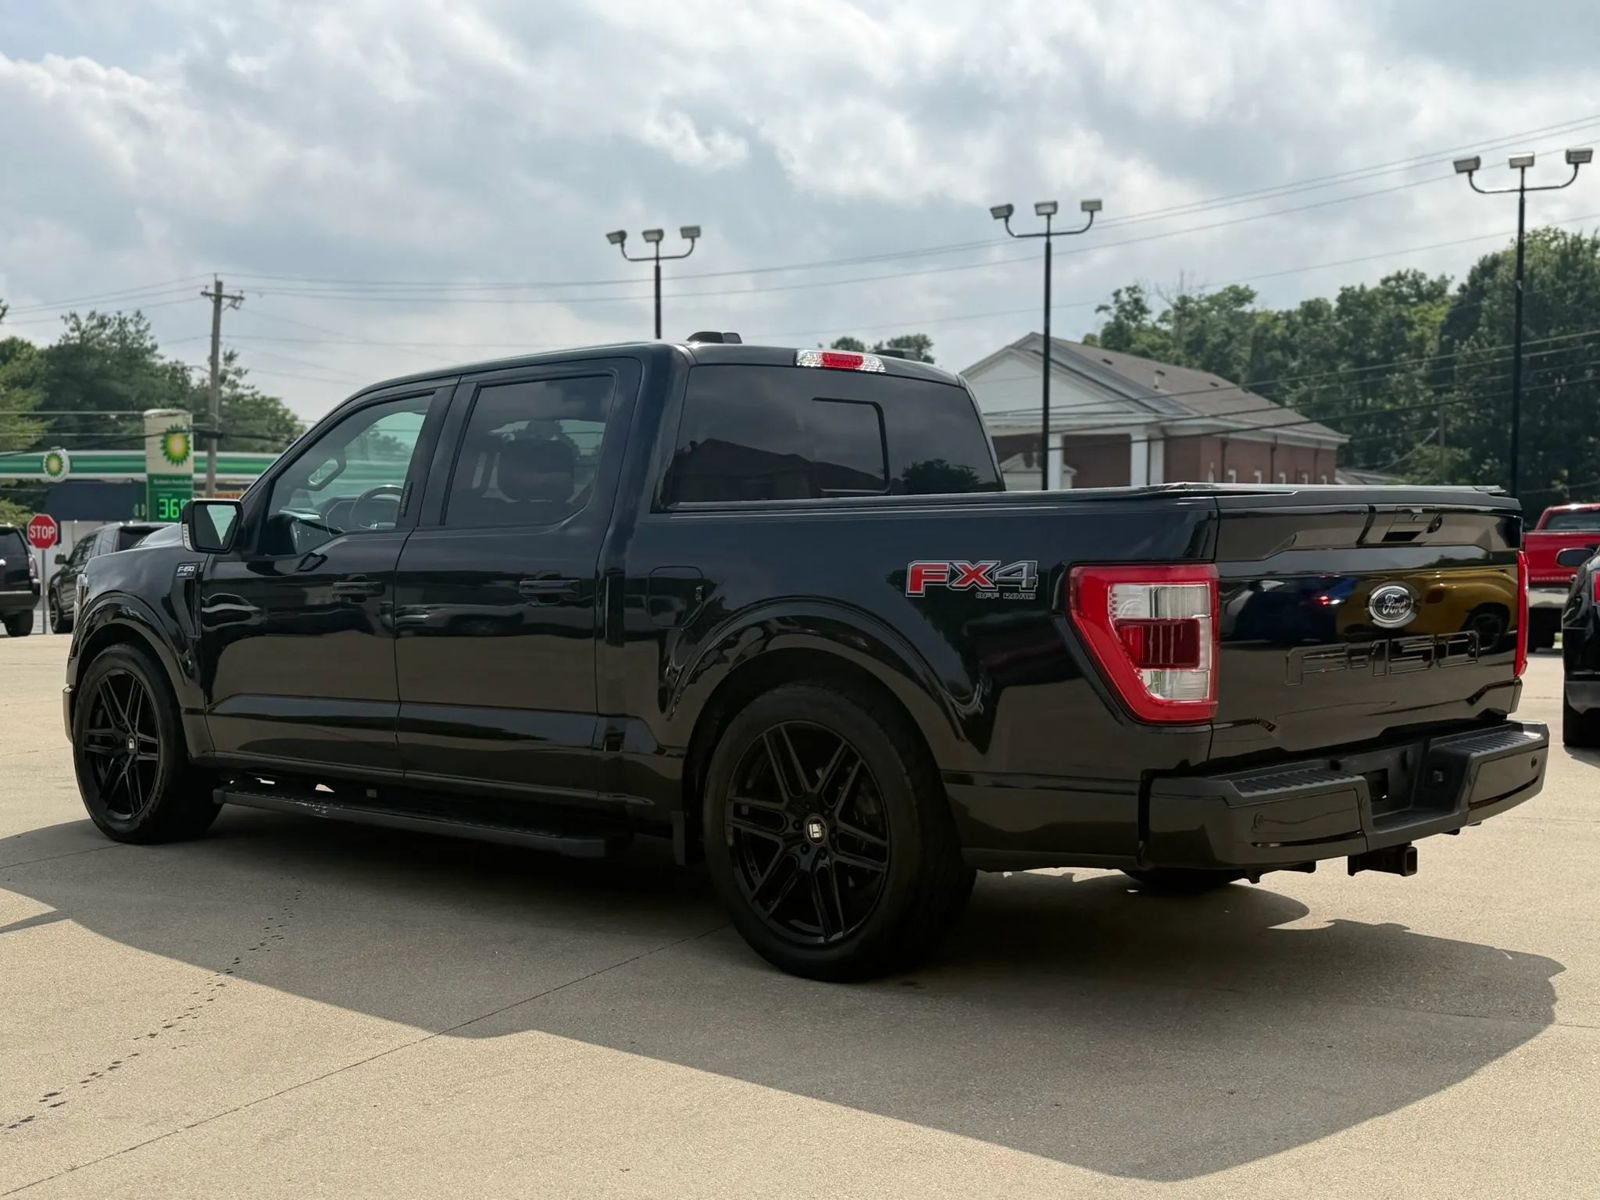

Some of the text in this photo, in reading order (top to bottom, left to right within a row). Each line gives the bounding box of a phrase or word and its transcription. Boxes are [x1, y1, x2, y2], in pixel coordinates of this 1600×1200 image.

[29, 525, 55, 540] STOP
[905, 560, 1039, 597] FX4
[1382, 593, 1409, 615] Ford
[1284, 630, 1480, 686] F-150
